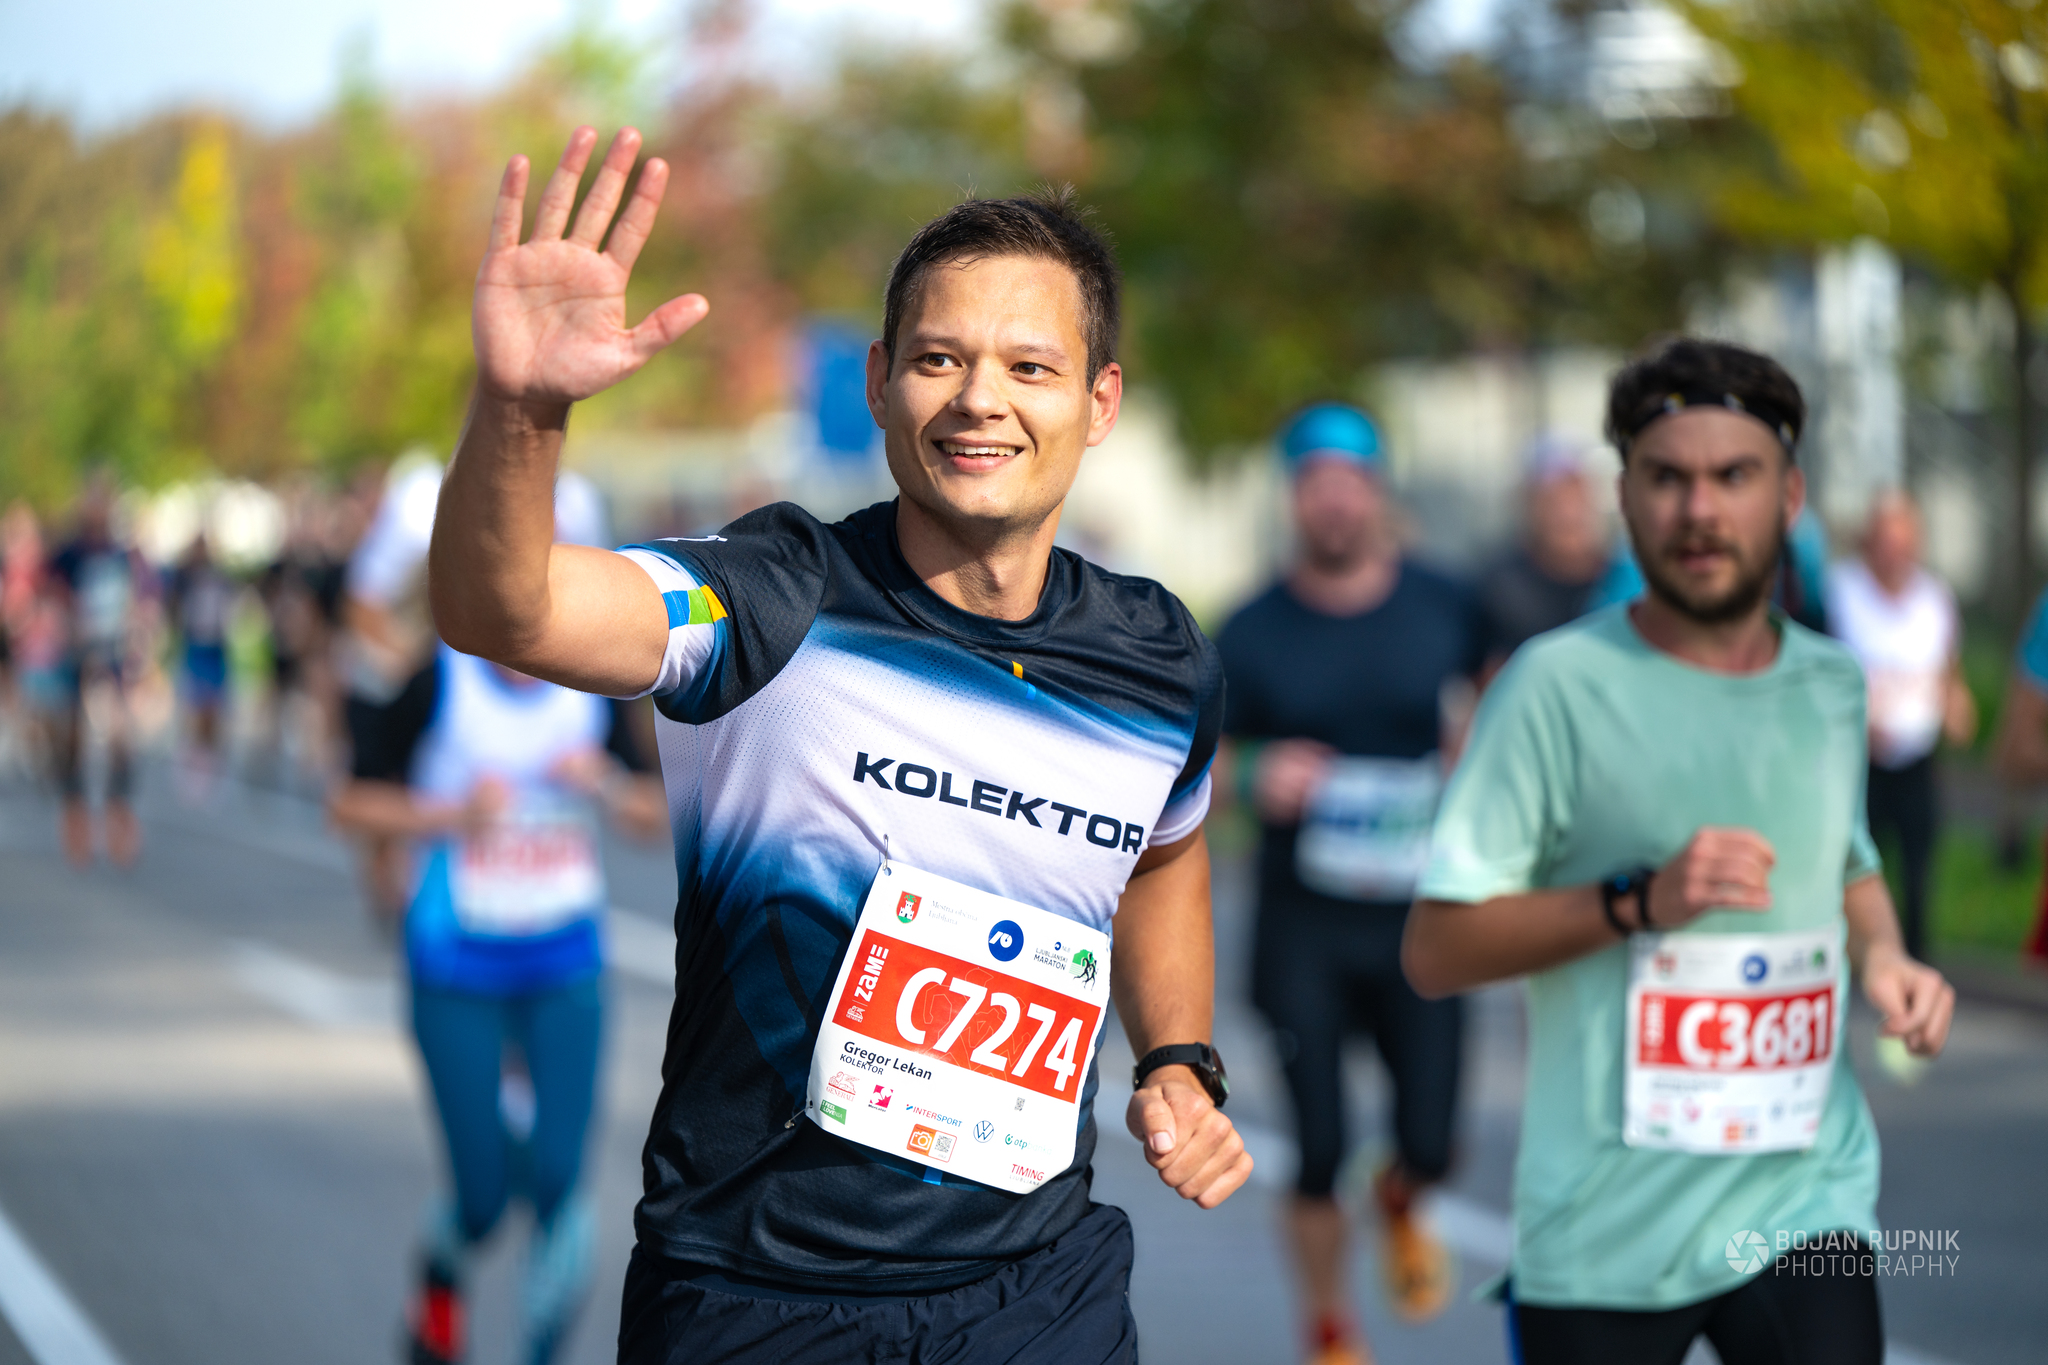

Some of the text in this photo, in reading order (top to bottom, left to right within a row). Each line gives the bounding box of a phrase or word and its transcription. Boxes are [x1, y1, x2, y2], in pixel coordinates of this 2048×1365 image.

[852, 751, 1145, 856] KOLEKTOR
[1033, 954, 1067, 971] MARATON
[895, 966, 1084, 1092] C7274
[1676, 993, 1829, 1067] C3681
[839, 1053, 884, 1075] KOLEKTOR
[843, 1041, 932, 1080] Gregor Lekan
[825, 1086, 855, 1102] GENERALI
[913, 1106, 963, 1127] INTERSPORT
[1011, 1163, 1045, 1181] TIMING
